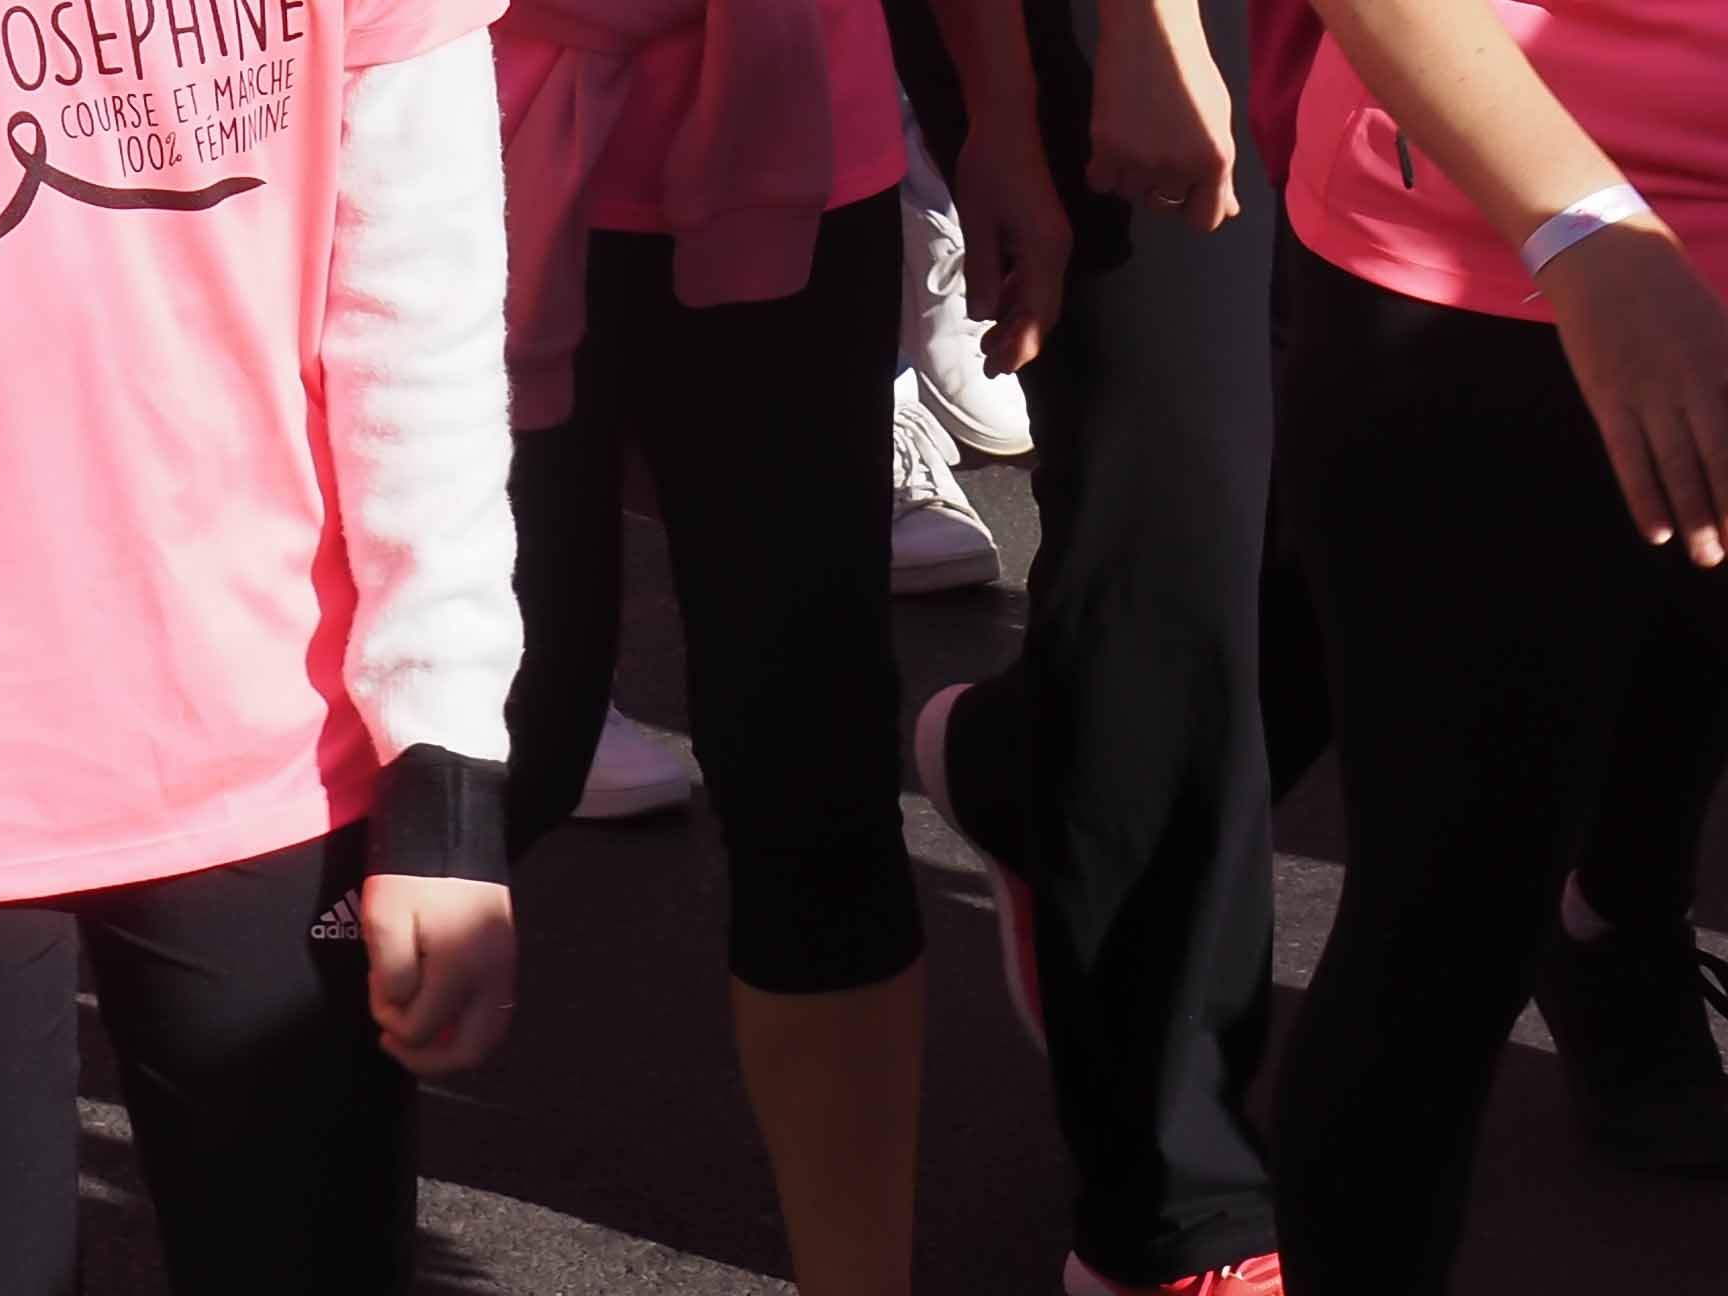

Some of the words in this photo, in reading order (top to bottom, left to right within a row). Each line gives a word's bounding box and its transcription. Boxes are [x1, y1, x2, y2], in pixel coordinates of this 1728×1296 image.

[60, 92, 157, 139] COURSE
[175, 83, 198, 124] ET
[213, 57, 296, 114] MARCHE
[117, 130, 183, 178] 100%
[195, 94, 291, 164] FÉMININE
